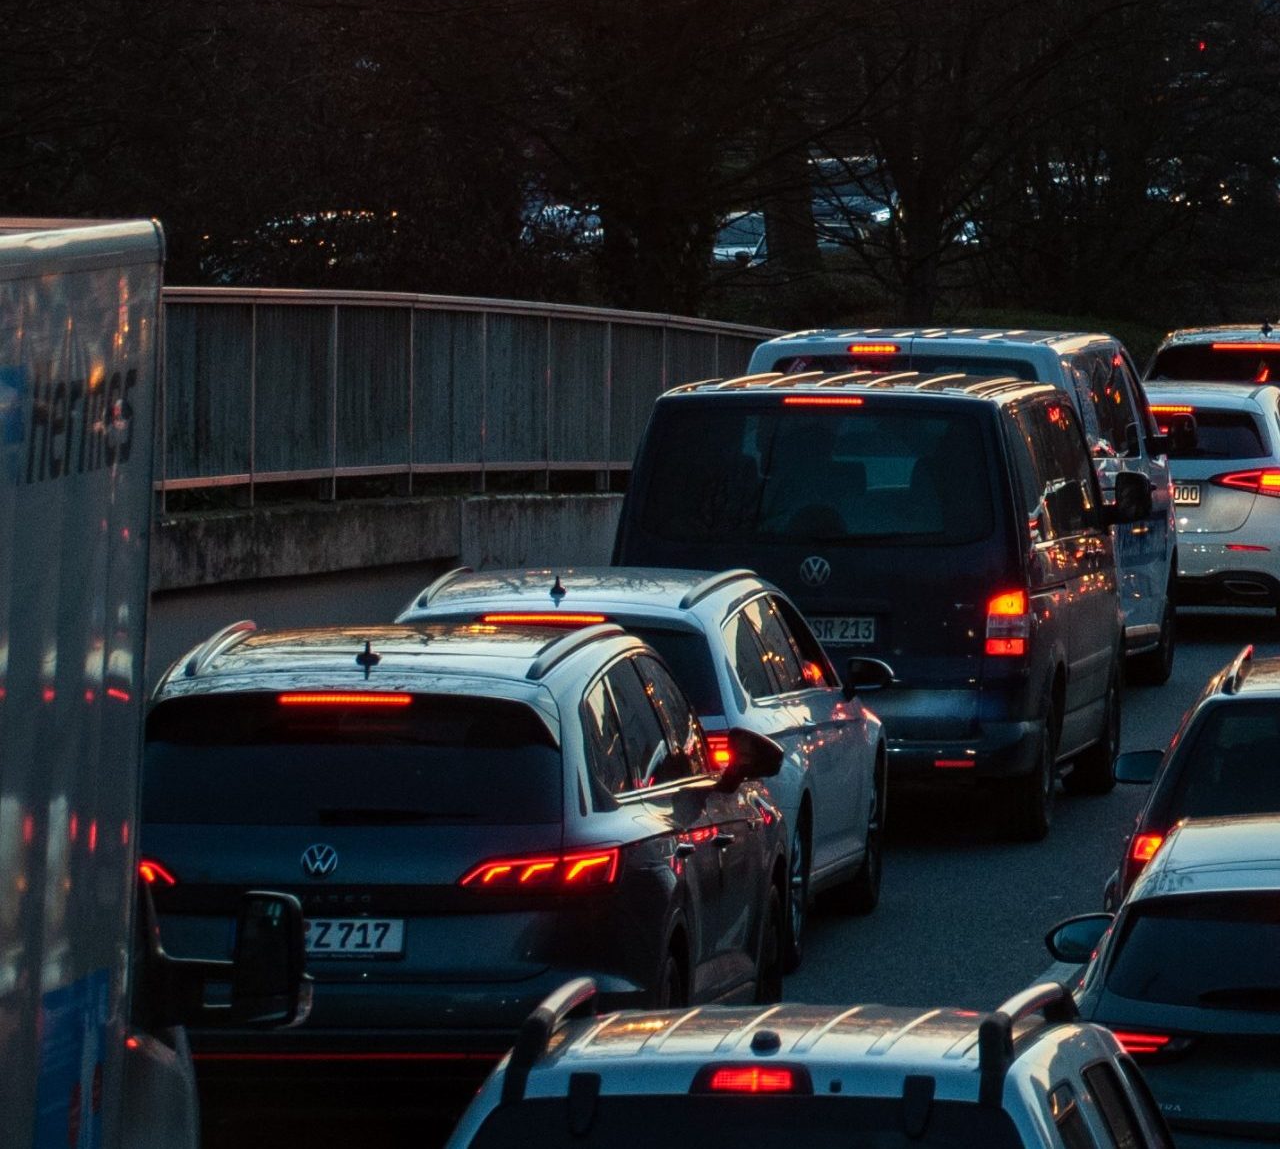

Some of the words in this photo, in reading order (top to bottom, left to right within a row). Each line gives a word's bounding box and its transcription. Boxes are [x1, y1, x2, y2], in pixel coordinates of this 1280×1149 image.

[839, 619, 873, 640] 213
[338, 922, 392, 949] 717
[1159, 1102, 1182, 1112] TRA
